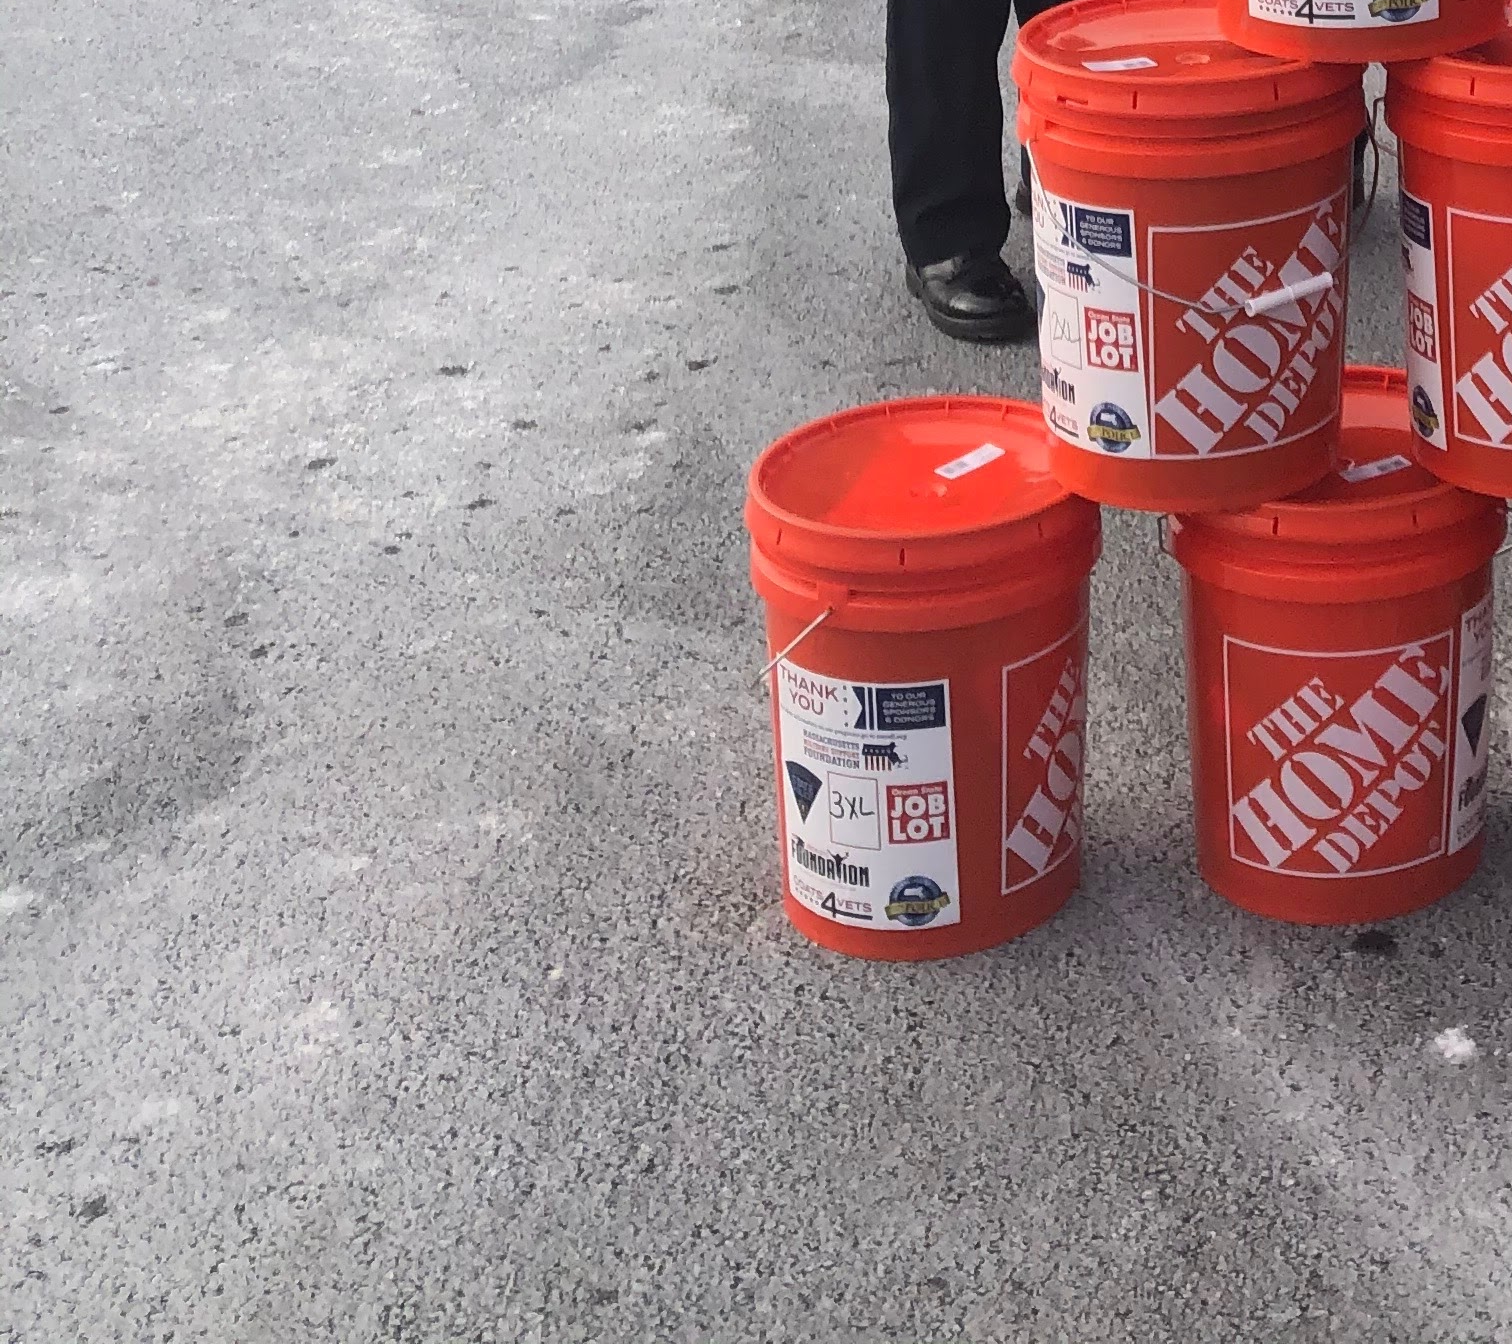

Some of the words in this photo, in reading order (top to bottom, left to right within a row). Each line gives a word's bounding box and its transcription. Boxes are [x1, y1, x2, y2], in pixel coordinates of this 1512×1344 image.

[1175, 245, 1274, 344] THE
[1088, 319, 1133, 346] JOB
[1154, 201, 1345, 455] HOME
[1089, 341, 1133, 369] LOT
[780, 664, 839, 702] THANK
[789, 689, 824, 715] YOU
[1247, 676, 1345, 762] THE
[1233, 645, 1449, 869] HOME
[829, 791, 875, 820] 3XL
[891, 794, 945, 818] JOB
[1314, 720, 1447, 875] DEPOT
[892, 816, 945, 841] LOT
